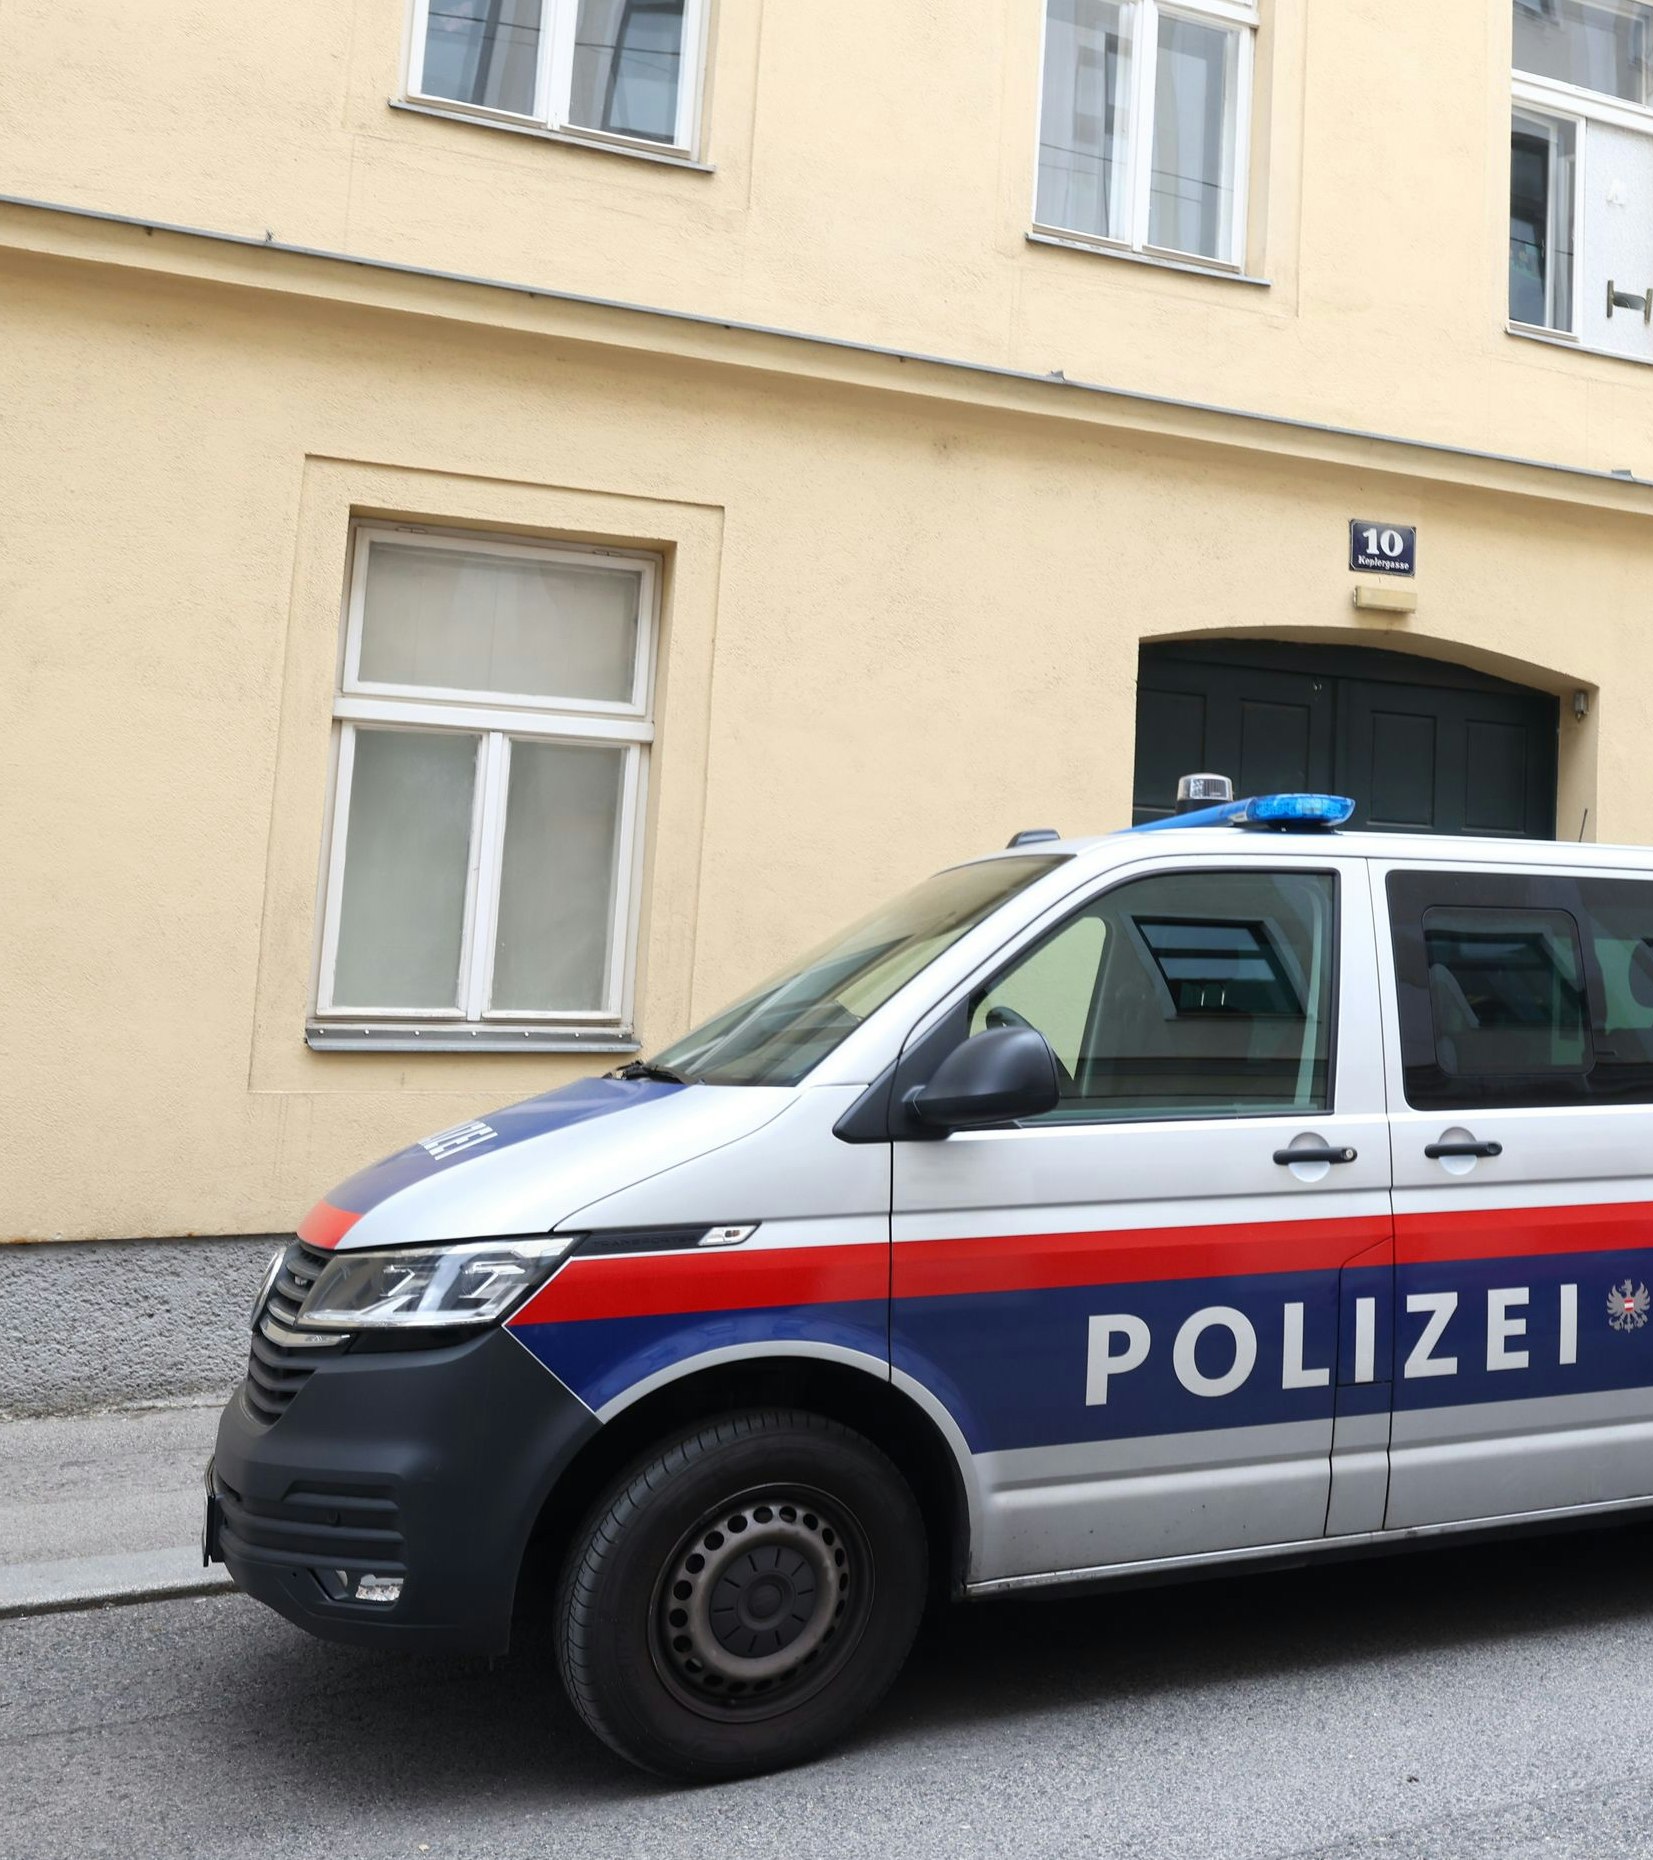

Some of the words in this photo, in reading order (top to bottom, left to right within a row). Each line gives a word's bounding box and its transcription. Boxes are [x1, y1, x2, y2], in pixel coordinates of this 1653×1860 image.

[1362, 527, 1404, 557] 10
[1358, 555, 1410, 571] Keplergasse
[1085, 1283, 1578, 1406] POLIZEI
